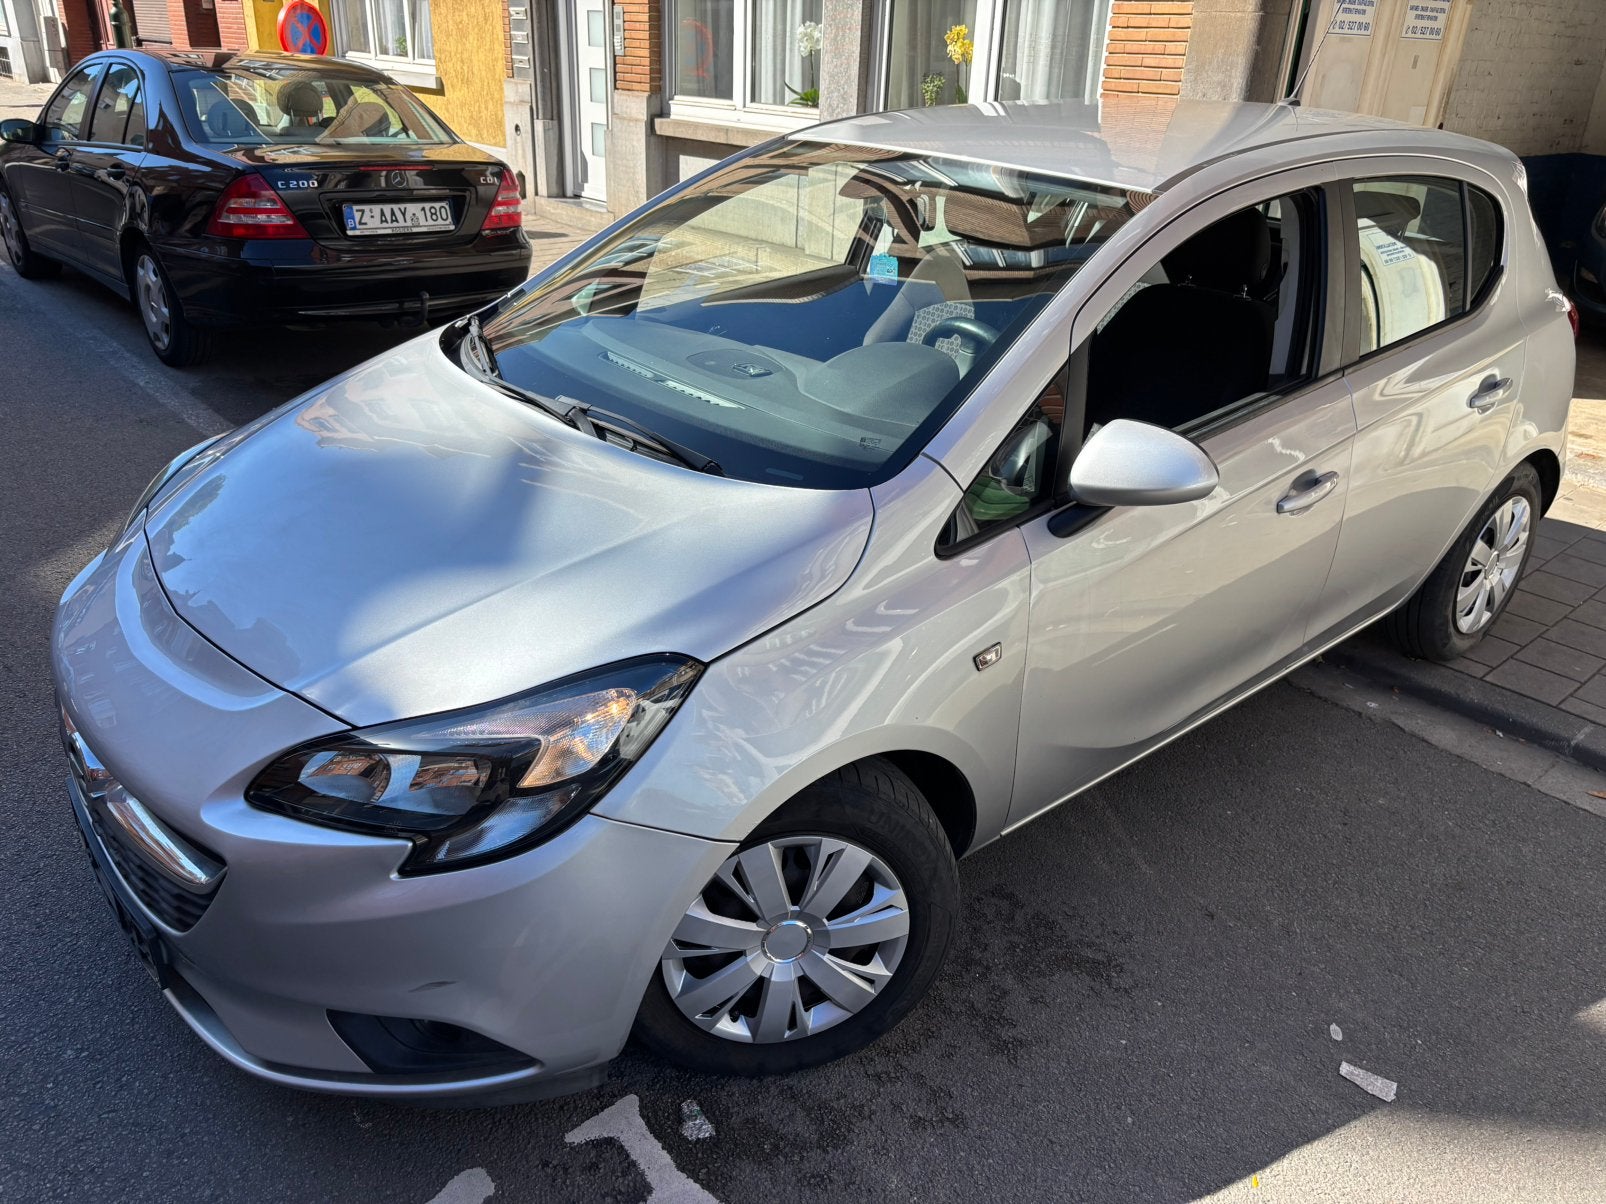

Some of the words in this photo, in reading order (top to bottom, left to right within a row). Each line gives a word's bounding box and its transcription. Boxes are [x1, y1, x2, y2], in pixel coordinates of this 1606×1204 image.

[277, 180, 287, 189] C
[289, 179, 319, 188] 200
[480, 176, 499, 185] CDI
[347, 218, 355, 228] B
